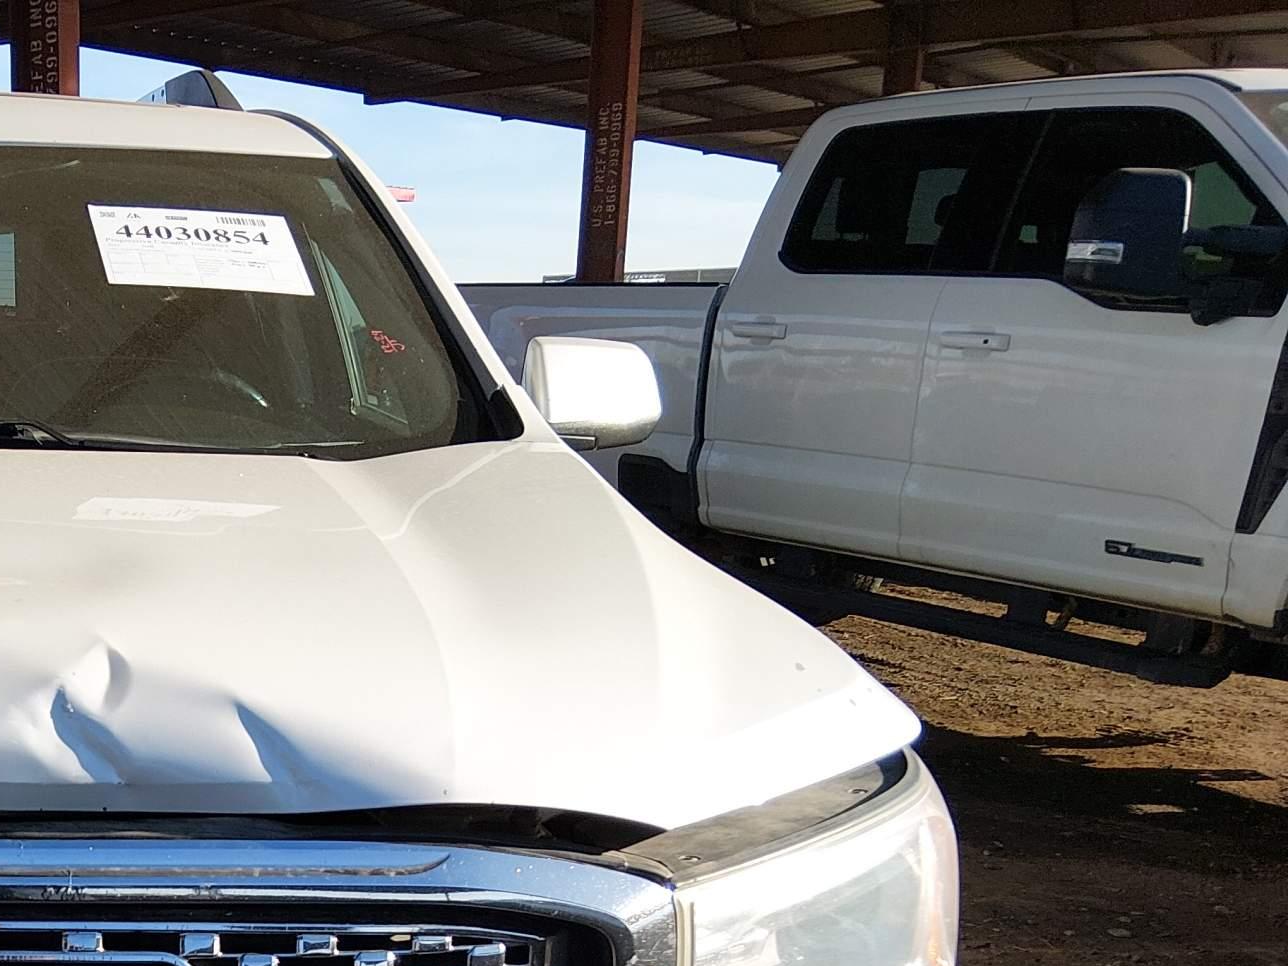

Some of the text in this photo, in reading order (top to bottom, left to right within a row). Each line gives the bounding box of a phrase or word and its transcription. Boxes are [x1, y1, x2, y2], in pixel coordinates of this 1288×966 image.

[599, 102, 610, 130] INC.
[593, 137, 607, 193] PREFAB
[604, 102, 623, 225] 1-866-799-0969
[115, 224, 270, 246] 44030854
